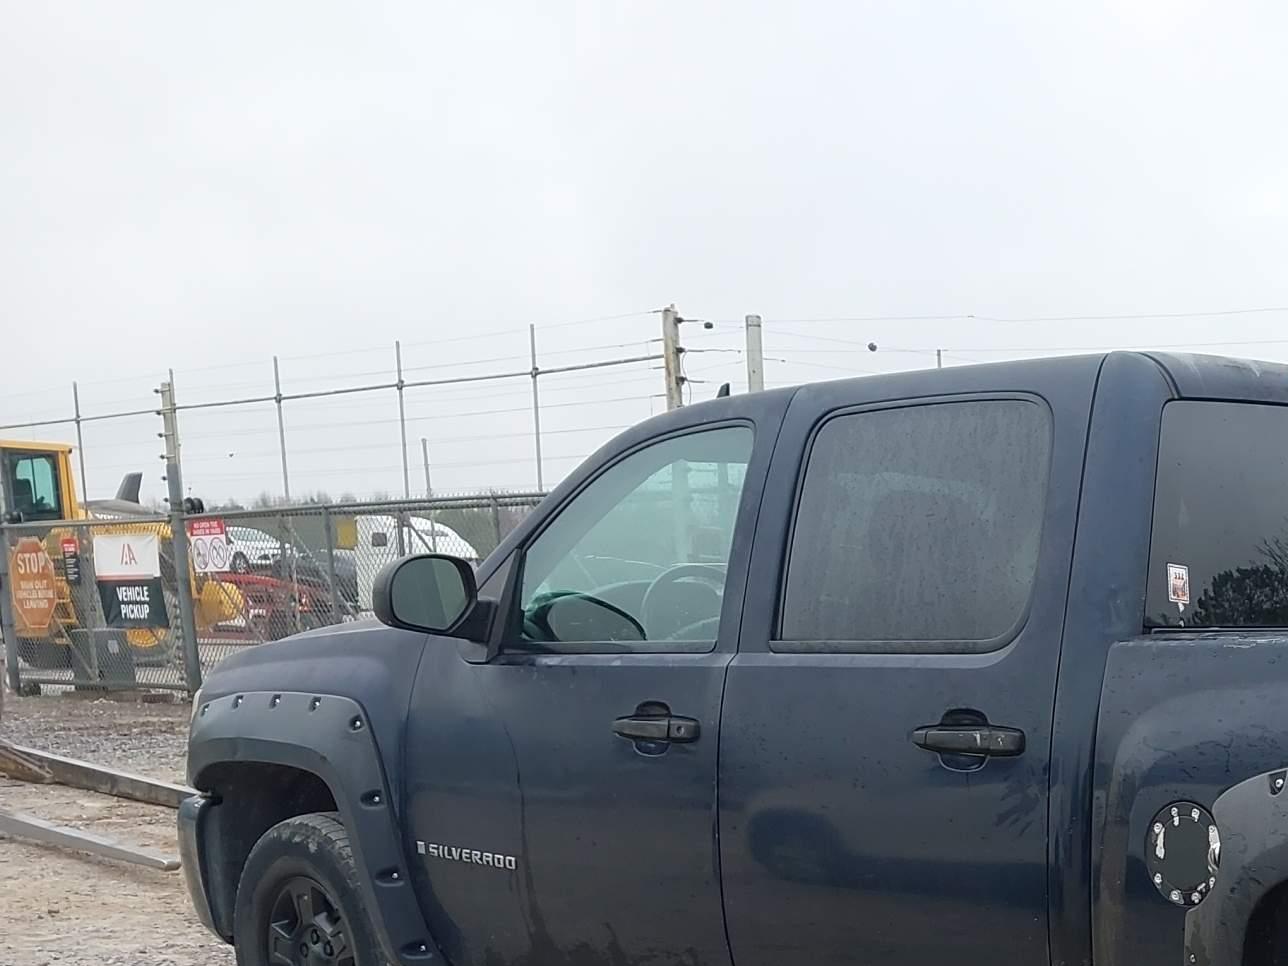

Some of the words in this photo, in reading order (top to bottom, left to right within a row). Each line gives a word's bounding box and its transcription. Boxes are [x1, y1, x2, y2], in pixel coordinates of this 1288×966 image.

[17, 552, 45, 574] STOP
[116, 586, 150, 602] VEHICLE
[120, 604, 150, 619] PICKUP
[428, 843, 517, 870] SILVERADO
